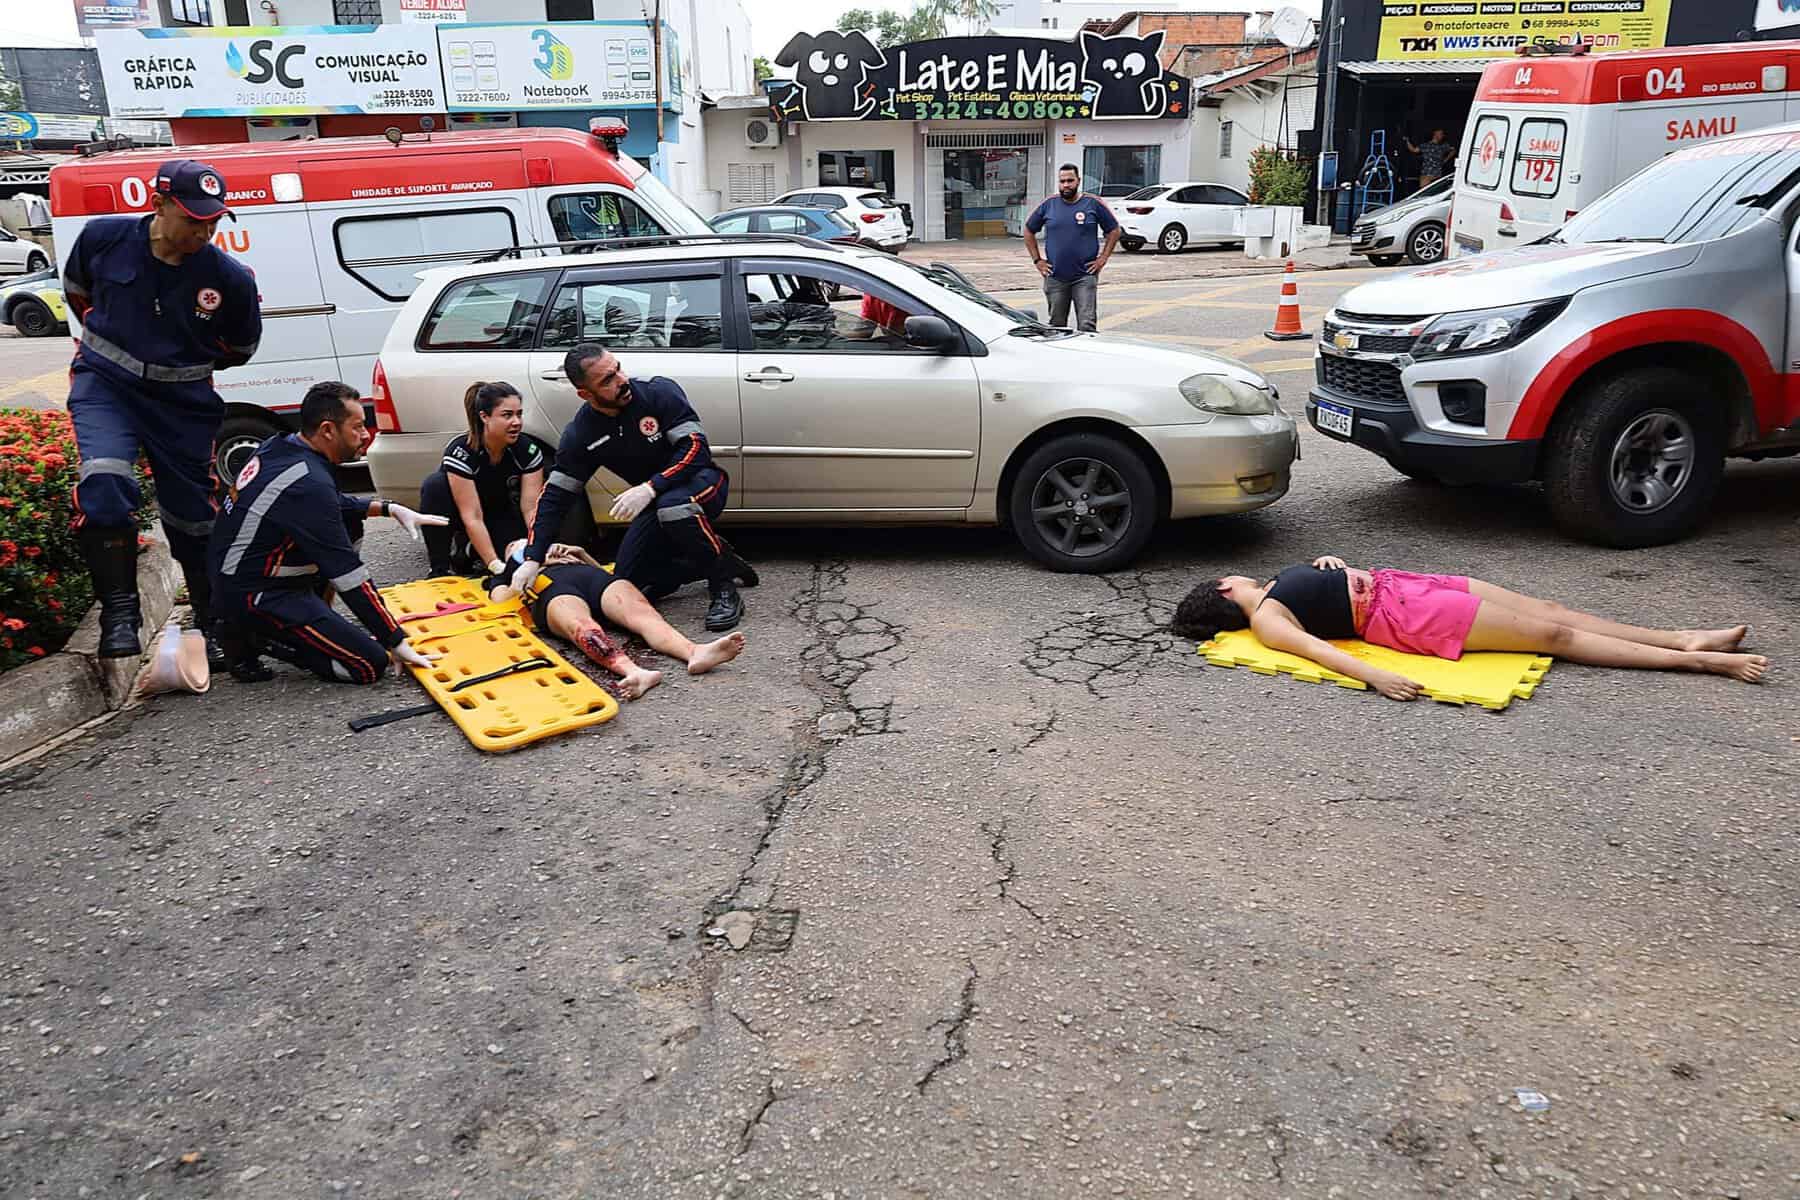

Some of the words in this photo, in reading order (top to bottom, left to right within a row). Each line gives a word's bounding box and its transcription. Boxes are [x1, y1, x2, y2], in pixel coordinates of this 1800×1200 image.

[1385, 6, 1414, 15] PEÇAS
[1423, 4, 1475, 13] ACESSÓRIOS
[1521, 3, 1562, 12] ELÉTRICA
[1571, 1, 1641, 12] CUSTOMIZAÇÕES
[1400, 37, 1437, 51] TXK
[124, 54, 197, 73] GRÁFICA
[244, 39, 306, 89] SC
[315, 50, 428, 69] COMUNICAÇÃO
[348, 71, 400, 83] VISUAL
[900, 50, 981, 92] Late
[987, 54, 1008, 92] E
[1016, 49, 1077, 92] Mia
[1515, 67, 1533, 85] 04
[133, 73, 194, 90] RÁPIDA
[1645, 67, 1686, 95] 04
[1702, 84, 1718, 92] RIO
[1719, 81, 1757, 91] BRANCO
[236, 91, 307, 105] PUBLICIDADES
[384, 89, 433, 98] 3228-8500
[896, 93, 911, 103] Pet
[912, 92, 934, 103] Shop
[948, 91, 963, 100] Pet
[964, 91, 1000, 101] Estética
[384, 98, 435, 107] 99911-2290
[914, 102, 1063, 119] 3224-4080
[1666, 116, 1736, 140] SAMU
[1529, 138, 1560, 152] SAMU
[1526, 159, 1556, 182] 192
[352, 187, 392, 197] UNIDADE
[394, 186, 406, 195] DE
[408, 184, 447, 194] SUPORTE
